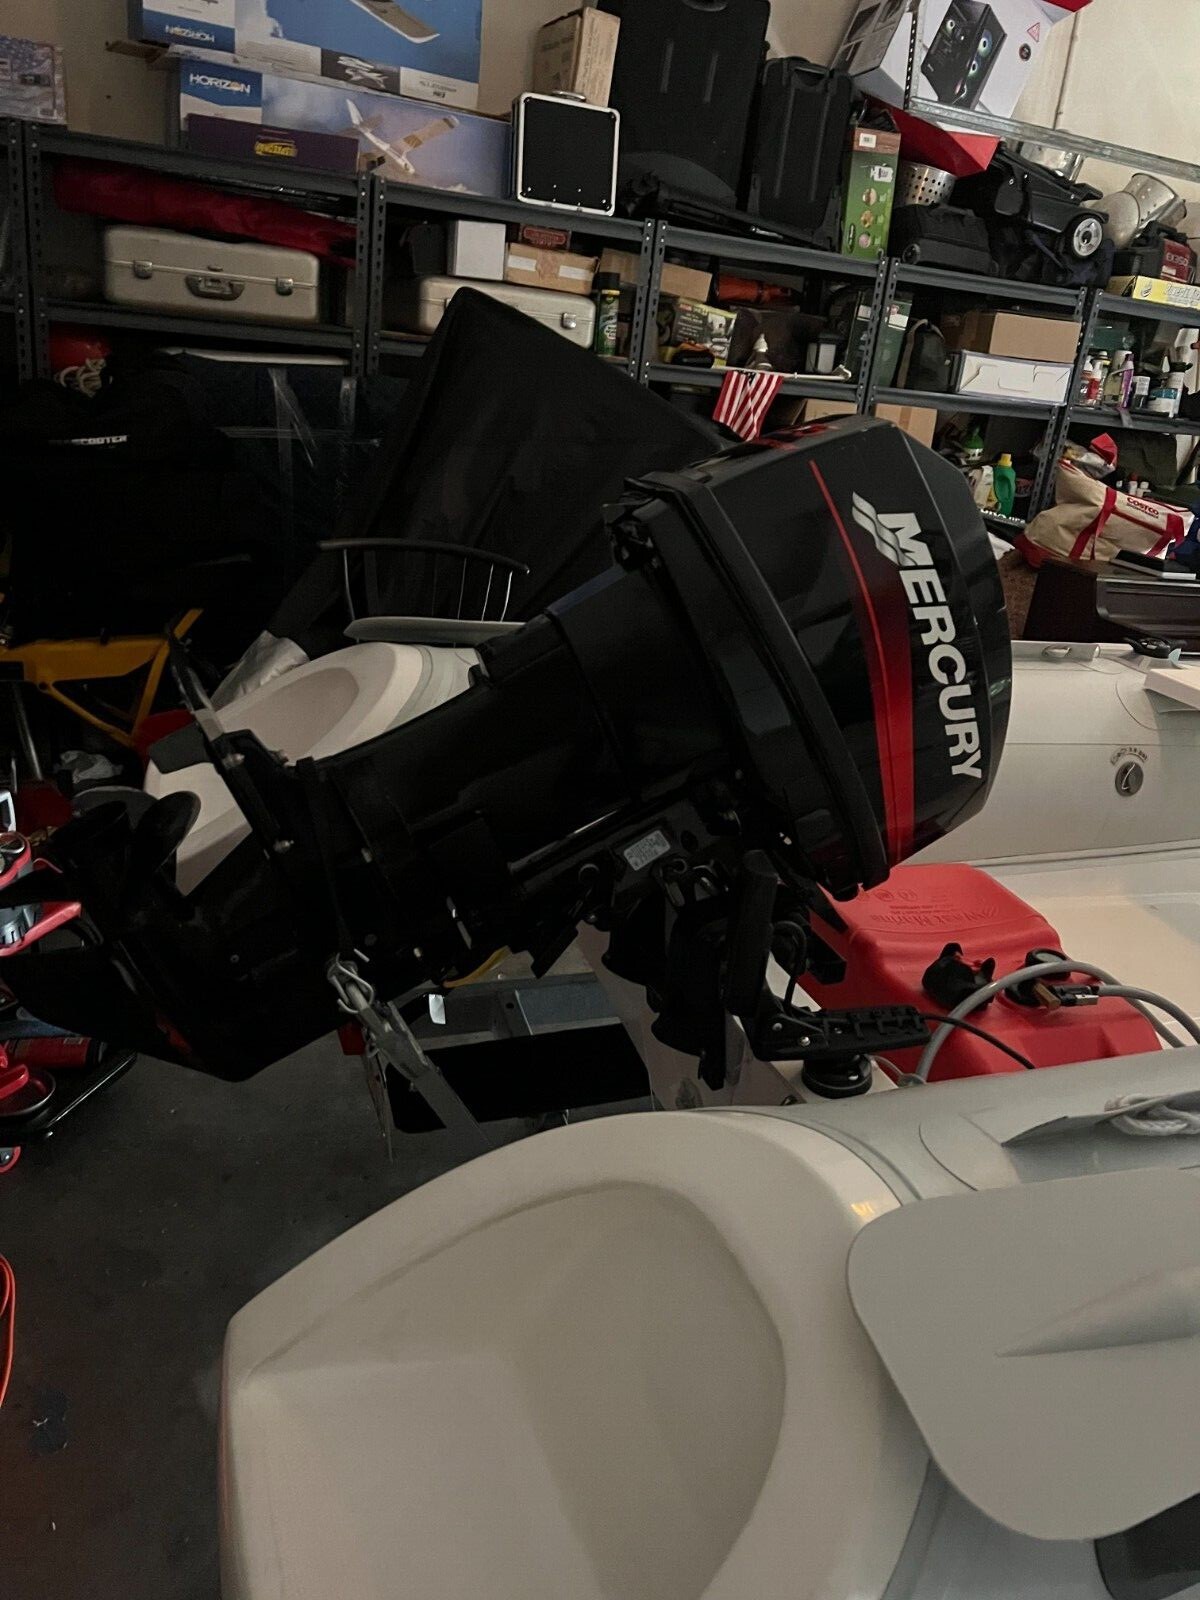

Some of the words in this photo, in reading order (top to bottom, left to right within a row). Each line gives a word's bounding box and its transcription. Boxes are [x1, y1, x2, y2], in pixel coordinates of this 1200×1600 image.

[189, 73, 251, 94] HORIZON
[1126, 497, 1160, 516] COSTCO
[876, 512, 982, 779] MERCURY
